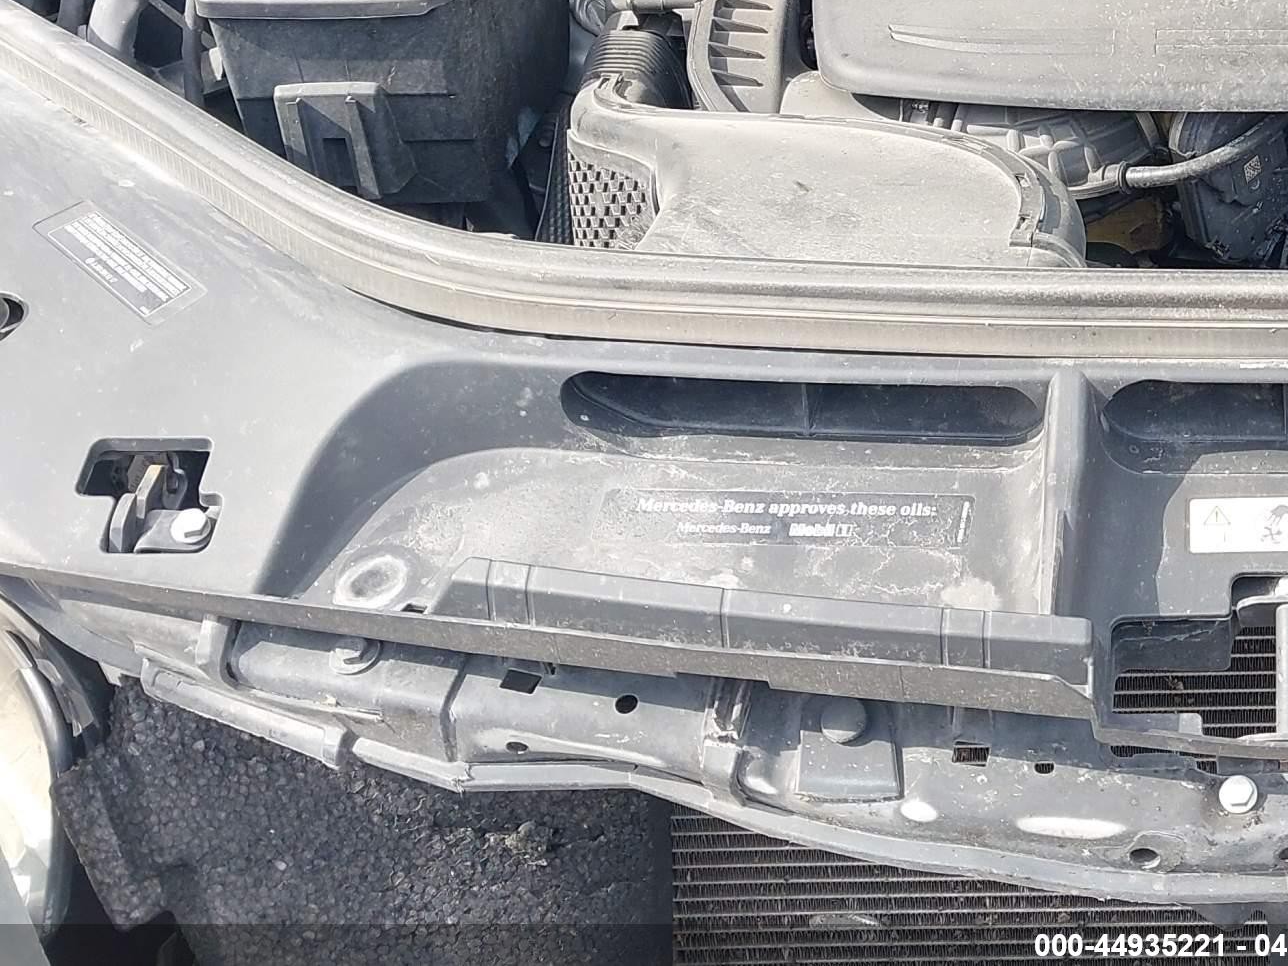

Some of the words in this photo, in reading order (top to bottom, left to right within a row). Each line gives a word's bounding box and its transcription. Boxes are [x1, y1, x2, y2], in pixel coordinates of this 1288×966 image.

[636, 498, 765, 514] Mercedes-Benz
[768, 502, 844, 518] approves
[850, 501, 897, 516] these
[900, 503, 937, 517] oils:
[676, 522, 772, 535] Mercedes-Benz
